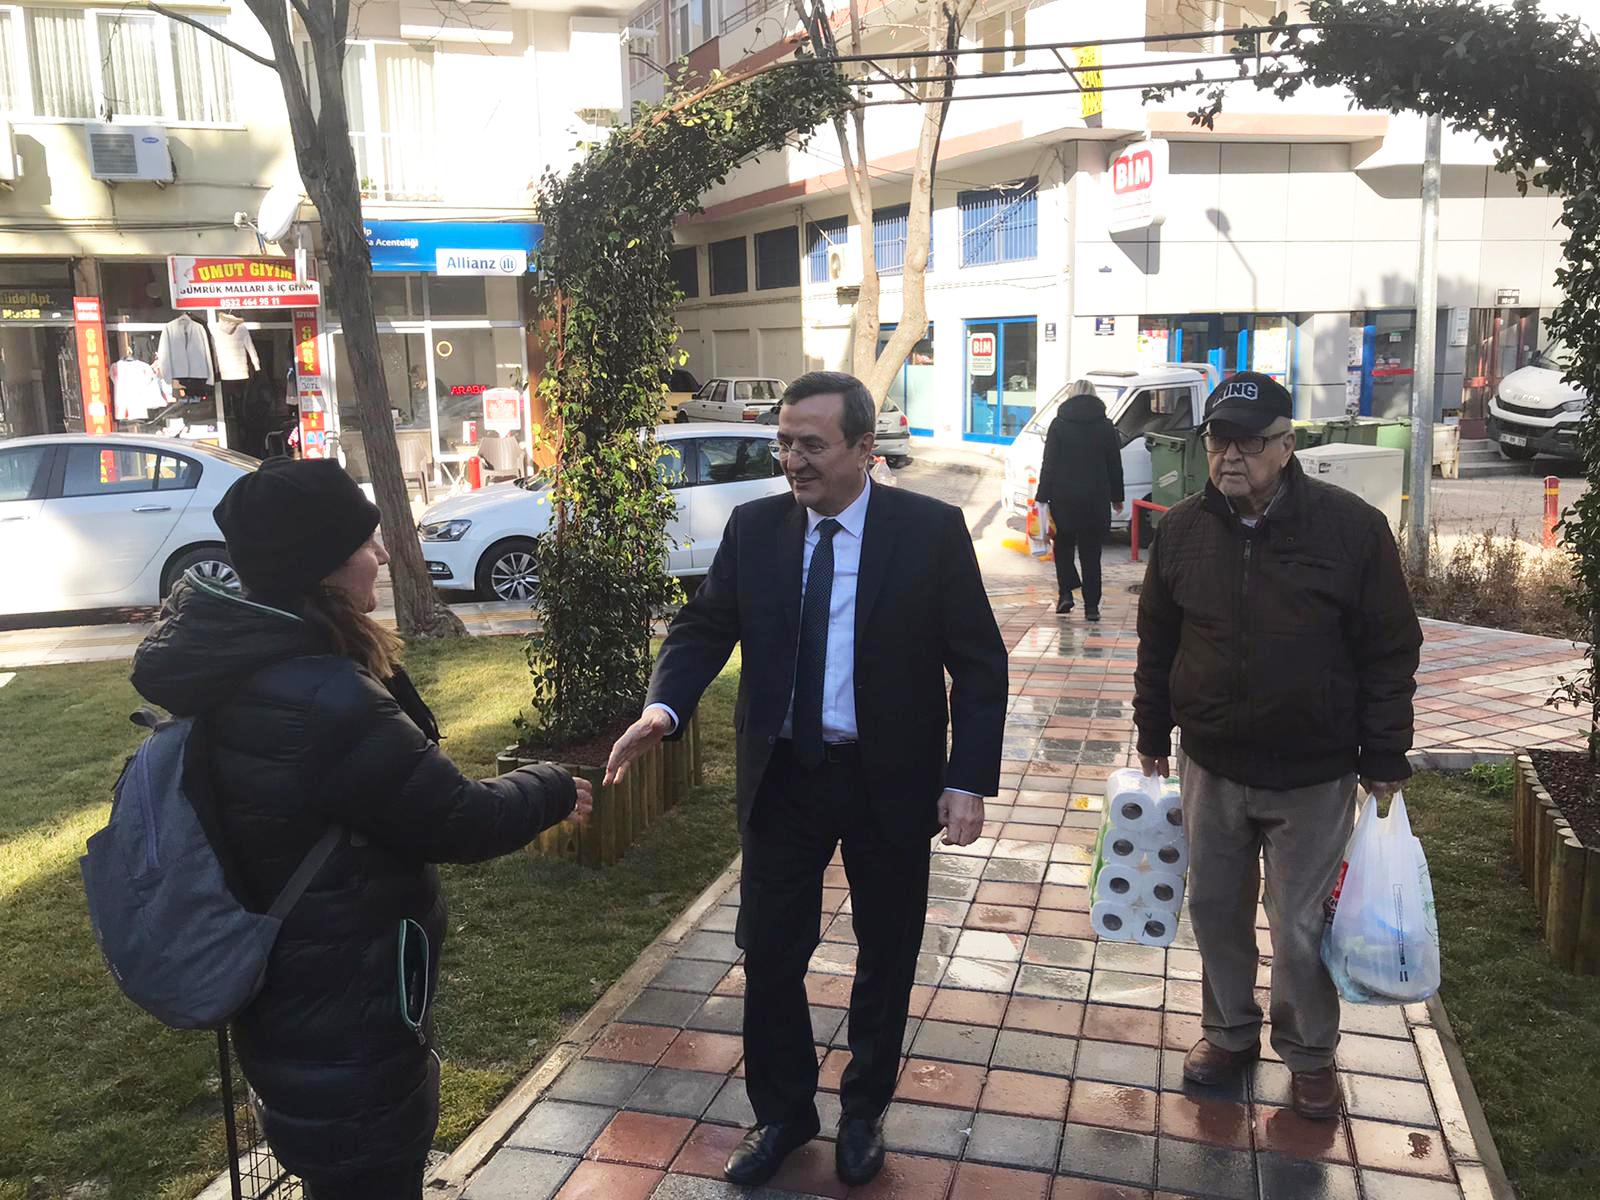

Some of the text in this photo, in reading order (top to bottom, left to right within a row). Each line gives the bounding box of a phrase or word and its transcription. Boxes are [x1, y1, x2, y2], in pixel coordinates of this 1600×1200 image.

[447, 256, 496, 270] Allianz
[197, 262, 245, 281] UMUT
[225, 283, 265, 293] MALLARI
[277, 282, 286, 294] İÇ
[451, 385, 487, 395] ARABA
